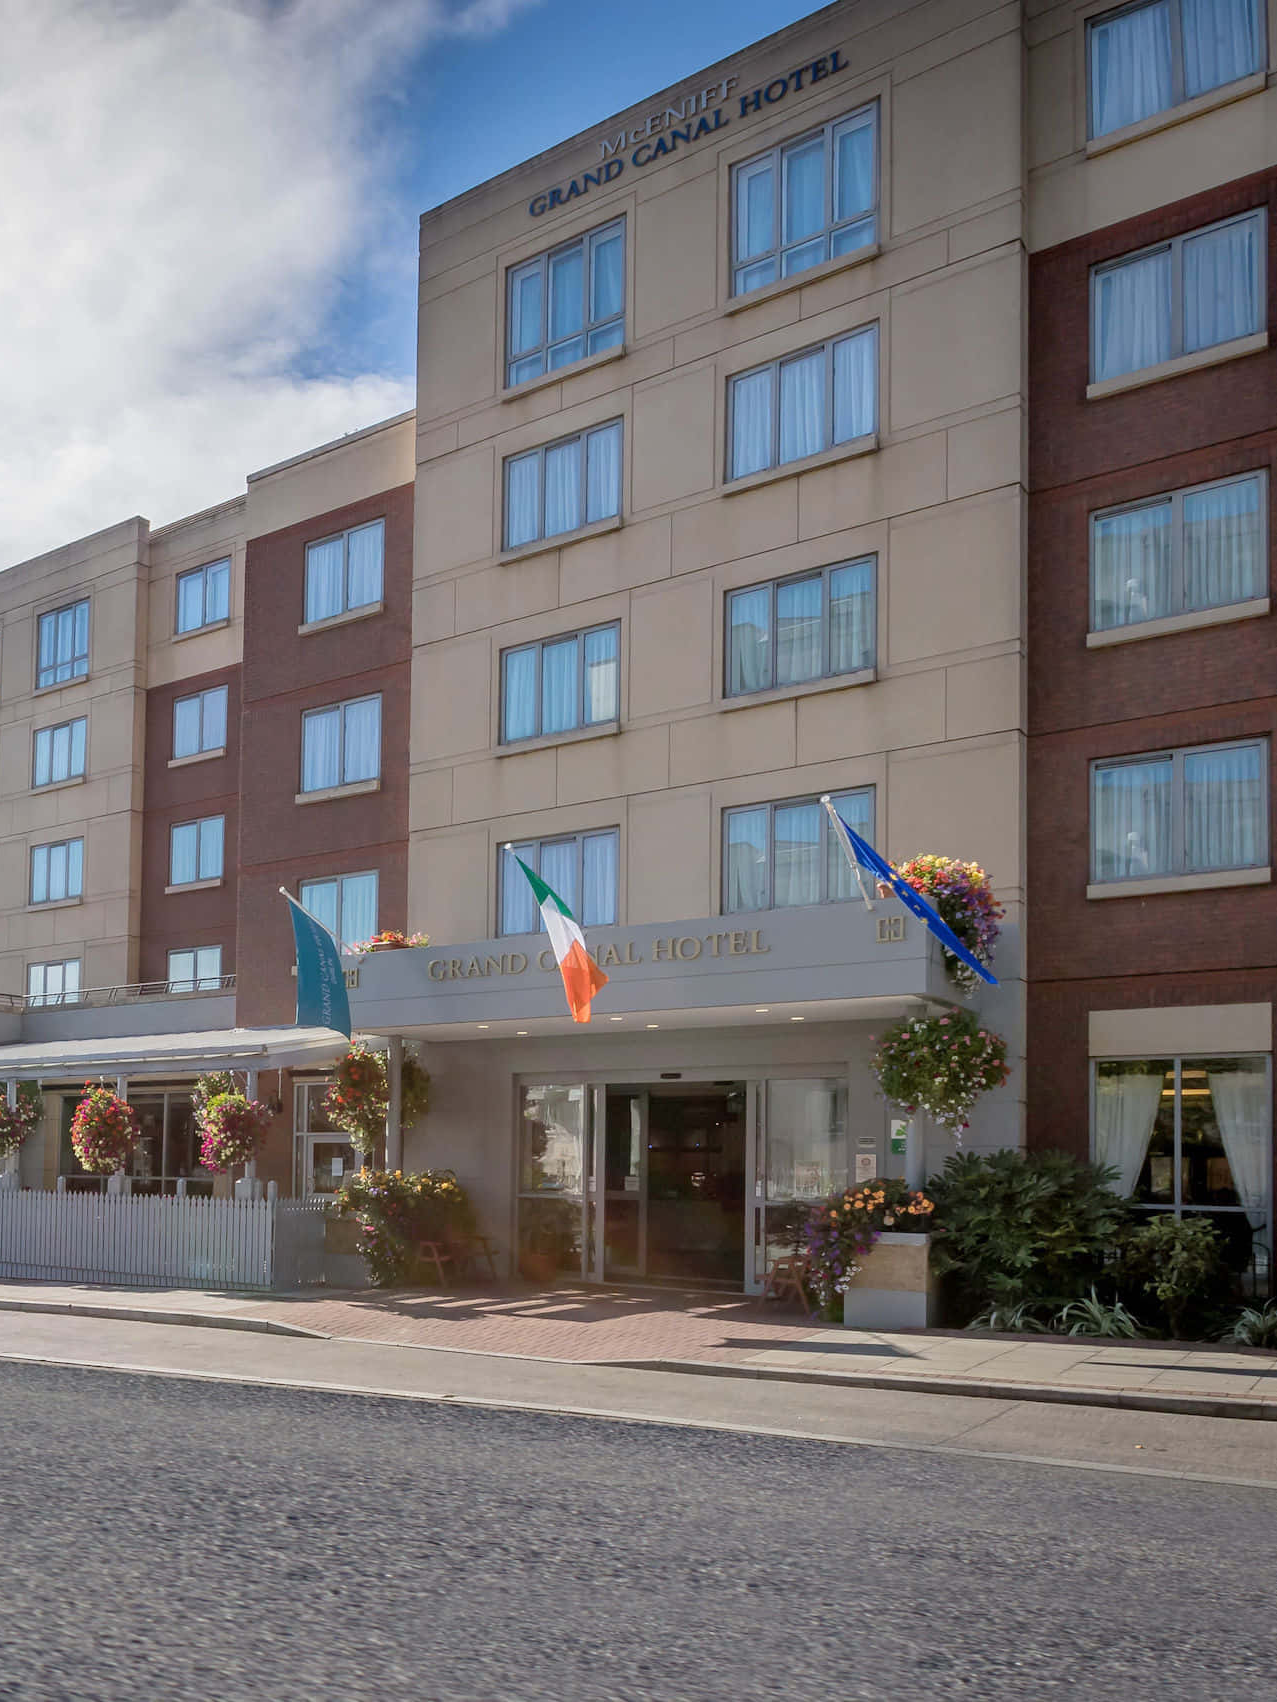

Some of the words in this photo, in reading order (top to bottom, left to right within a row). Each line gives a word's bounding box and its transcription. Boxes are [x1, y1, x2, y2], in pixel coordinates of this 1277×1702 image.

[528, 158, 624, 218] GRAND
[631, 109, 730, 168] CANAL
[739, 50, 850, 118] HOTEL
[598, 72, 740, 159] McENIFF
[428, 951, 528, 982] GRAND
[538, 941, 644, 973] CNAL
[652, 928, 772, 962] HOTEL
